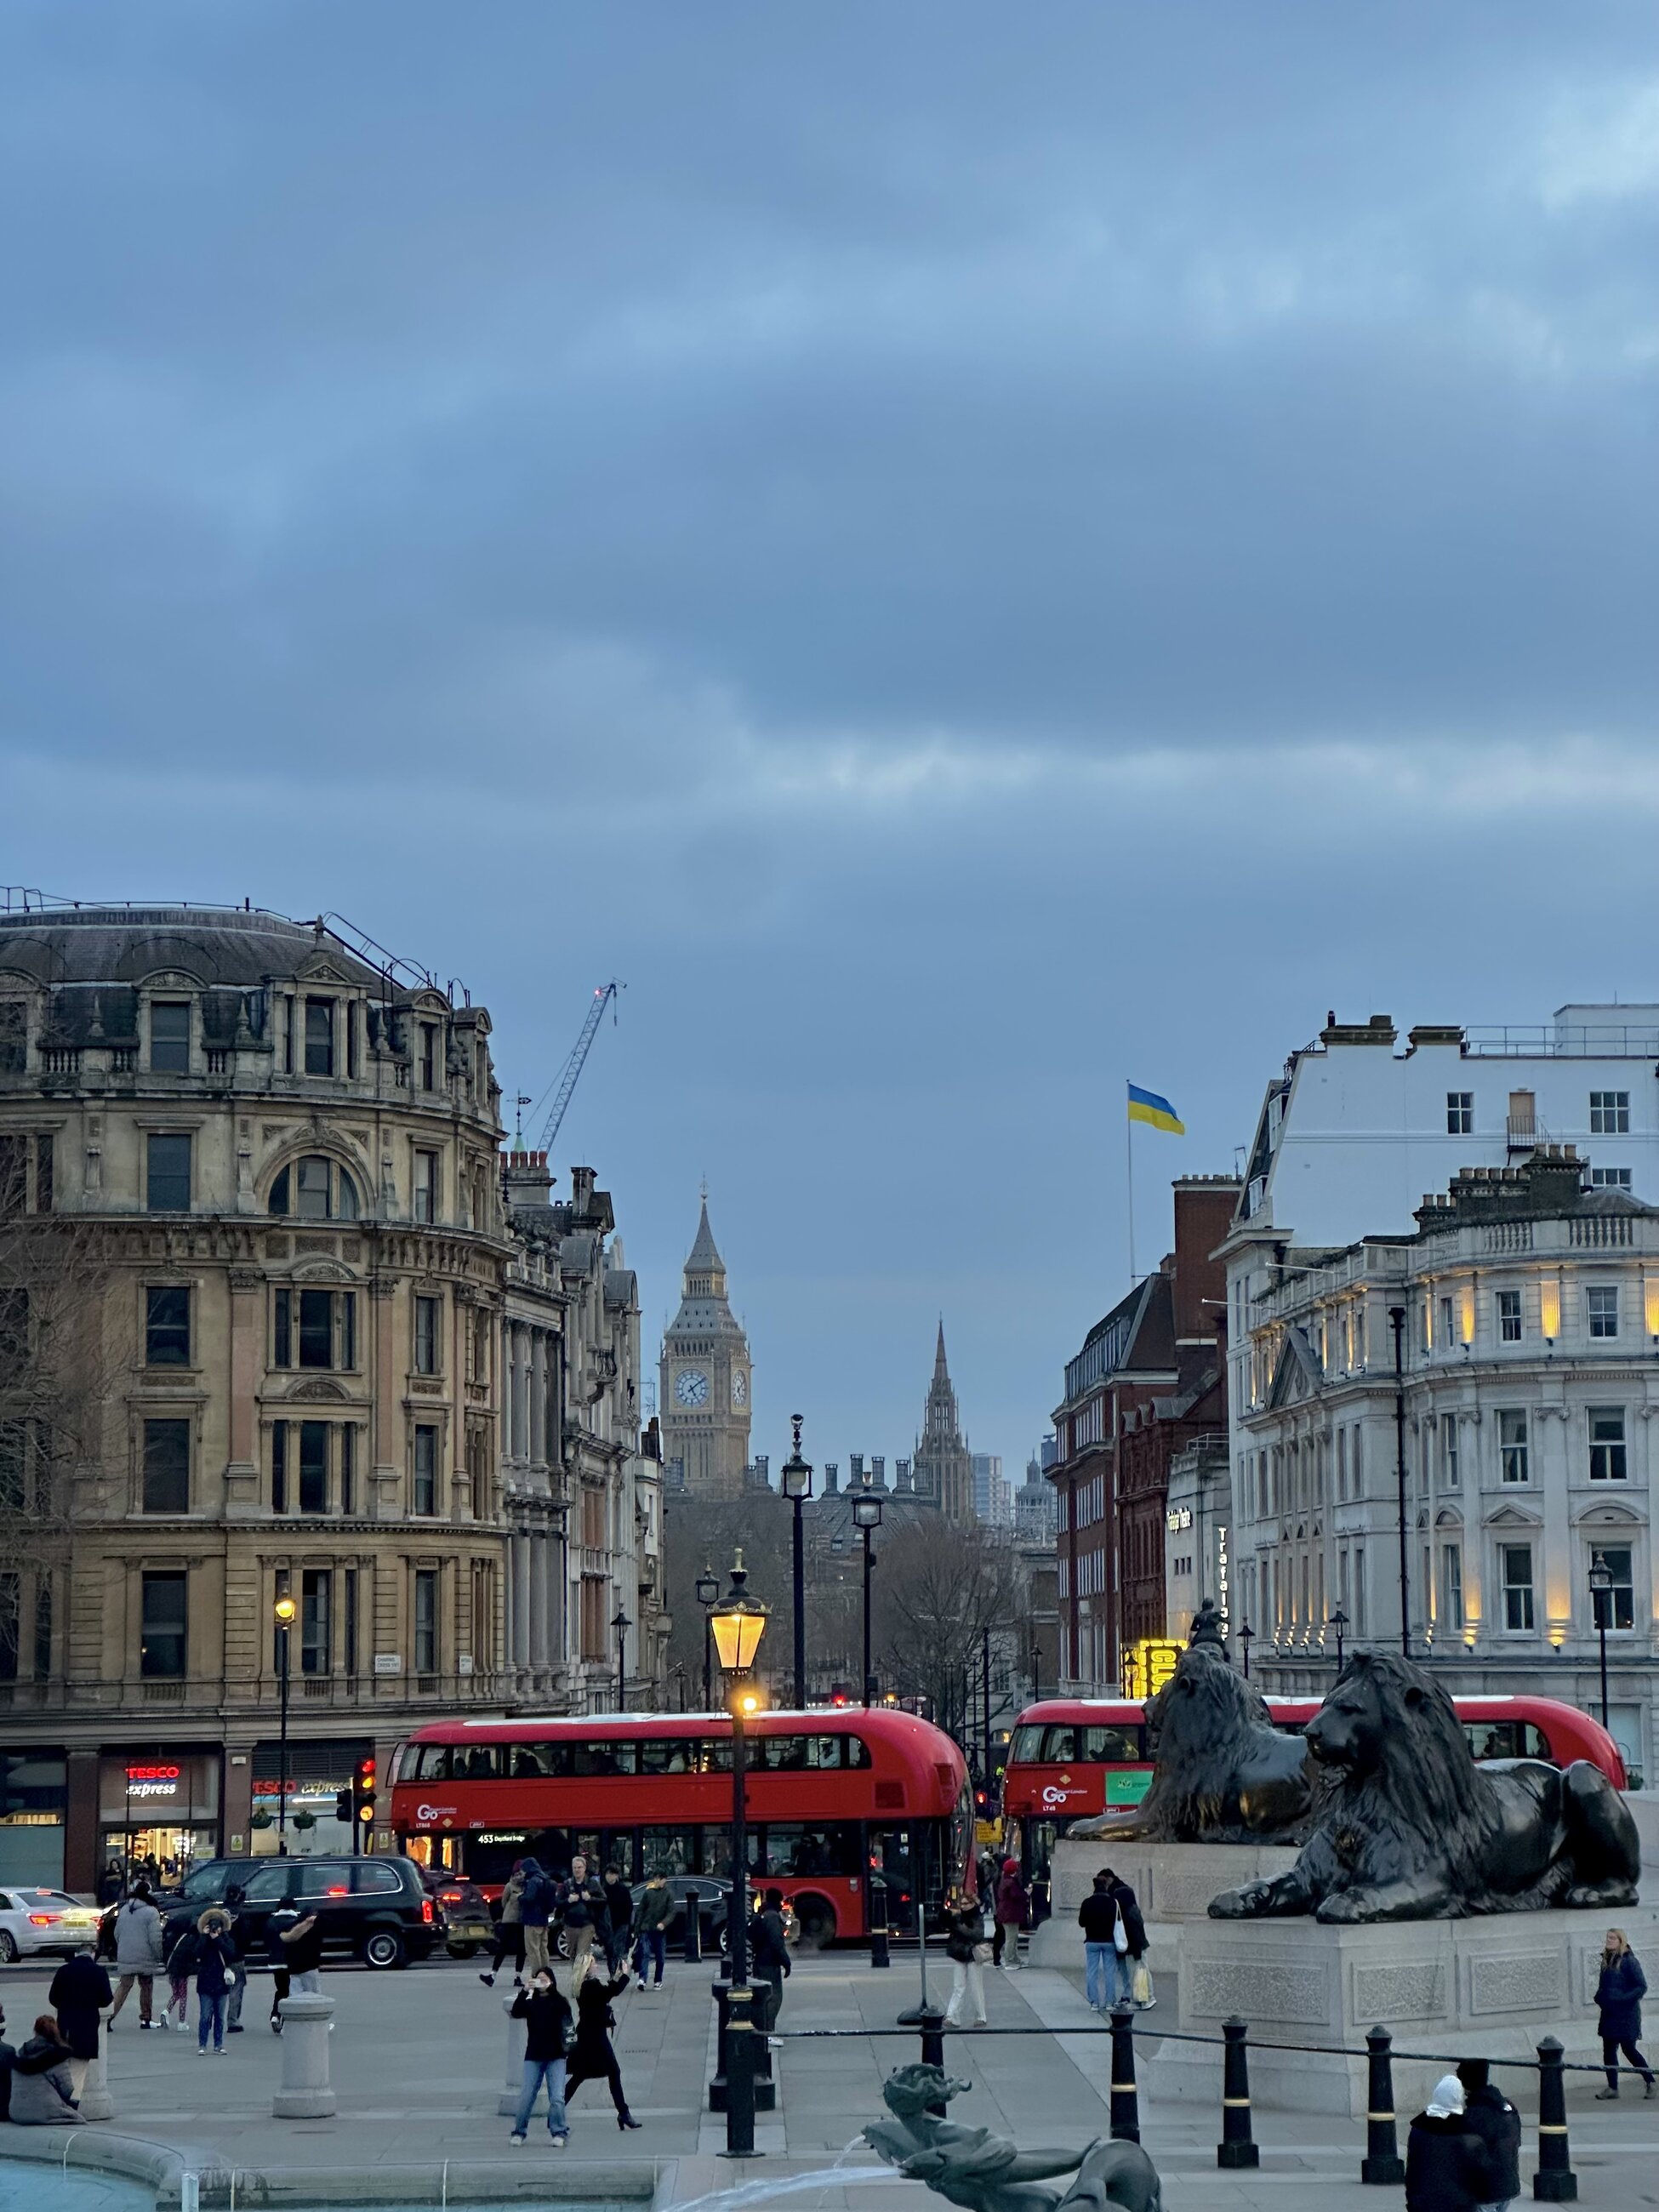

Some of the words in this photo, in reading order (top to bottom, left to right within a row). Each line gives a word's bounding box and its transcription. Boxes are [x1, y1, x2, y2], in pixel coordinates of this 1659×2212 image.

[125, 1767, 180, 1779] TESCO
[125, 1784, 176, 1799] express
[1043, 1787, 1066, 1803] Go
[417, 1804, 438, 1821] Go
[478, 1834, 493, 1844] 453
